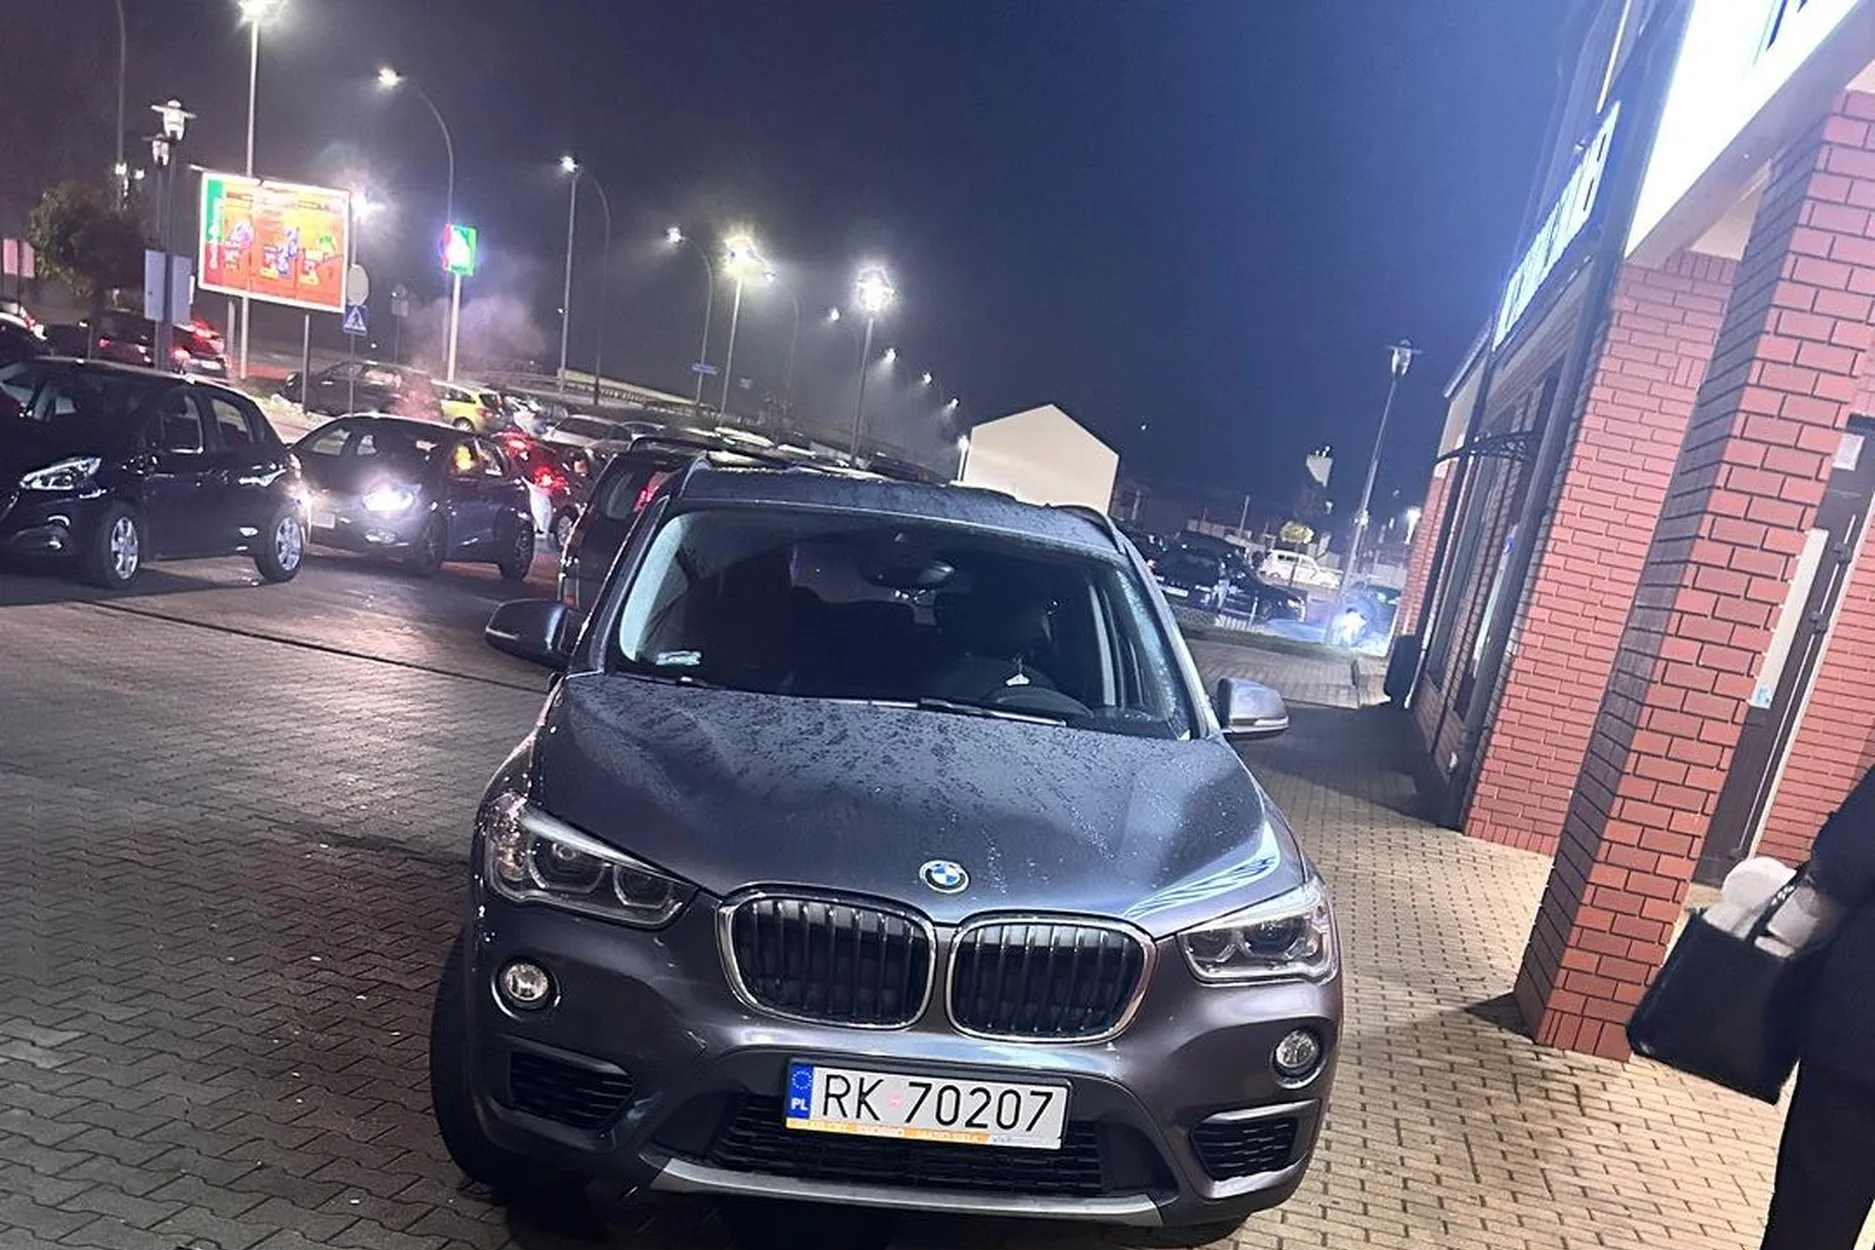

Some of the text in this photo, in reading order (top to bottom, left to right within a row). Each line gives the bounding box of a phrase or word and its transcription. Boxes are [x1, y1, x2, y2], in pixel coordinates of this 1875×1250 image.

[791, 1097, 809, 1110] PL
[823, 1074, 1054, 1132] RK 70207
